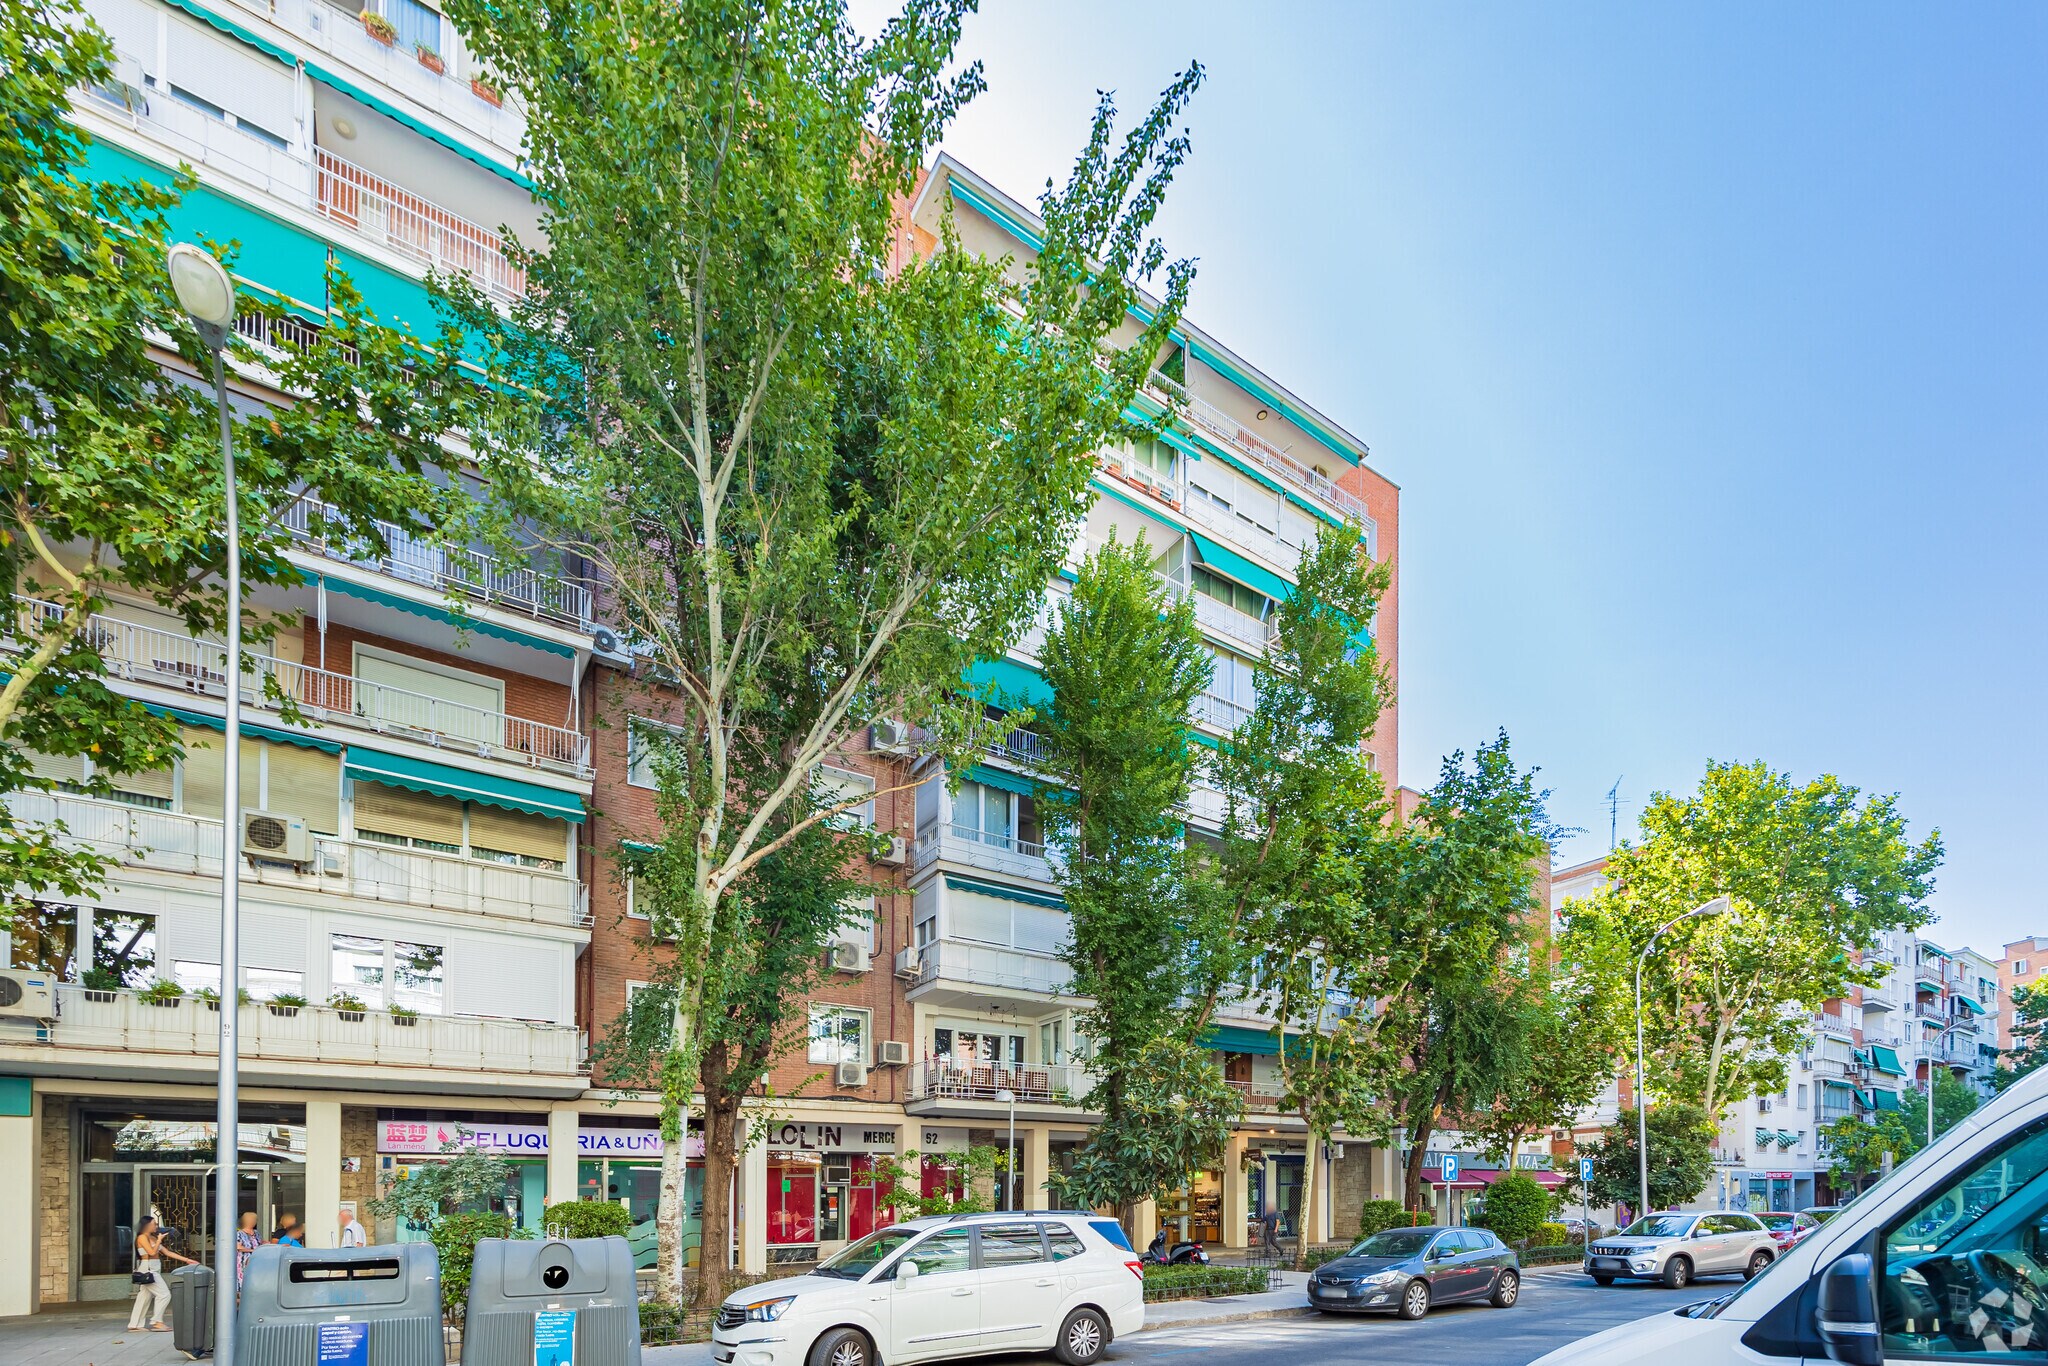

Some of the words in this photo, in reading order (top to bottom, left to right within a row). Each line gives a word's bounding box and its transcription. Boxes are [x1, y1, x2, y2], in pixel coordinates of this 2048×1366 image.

[459, 1132, 611, 1150] PELUQRIA
[627, 1133, 665, 1150] UÑ
[863, 1131, 895, 1144] MERCE
[1445, 1157, 1456, 1178] P
[1582, 1161, 1591, 1178] P
